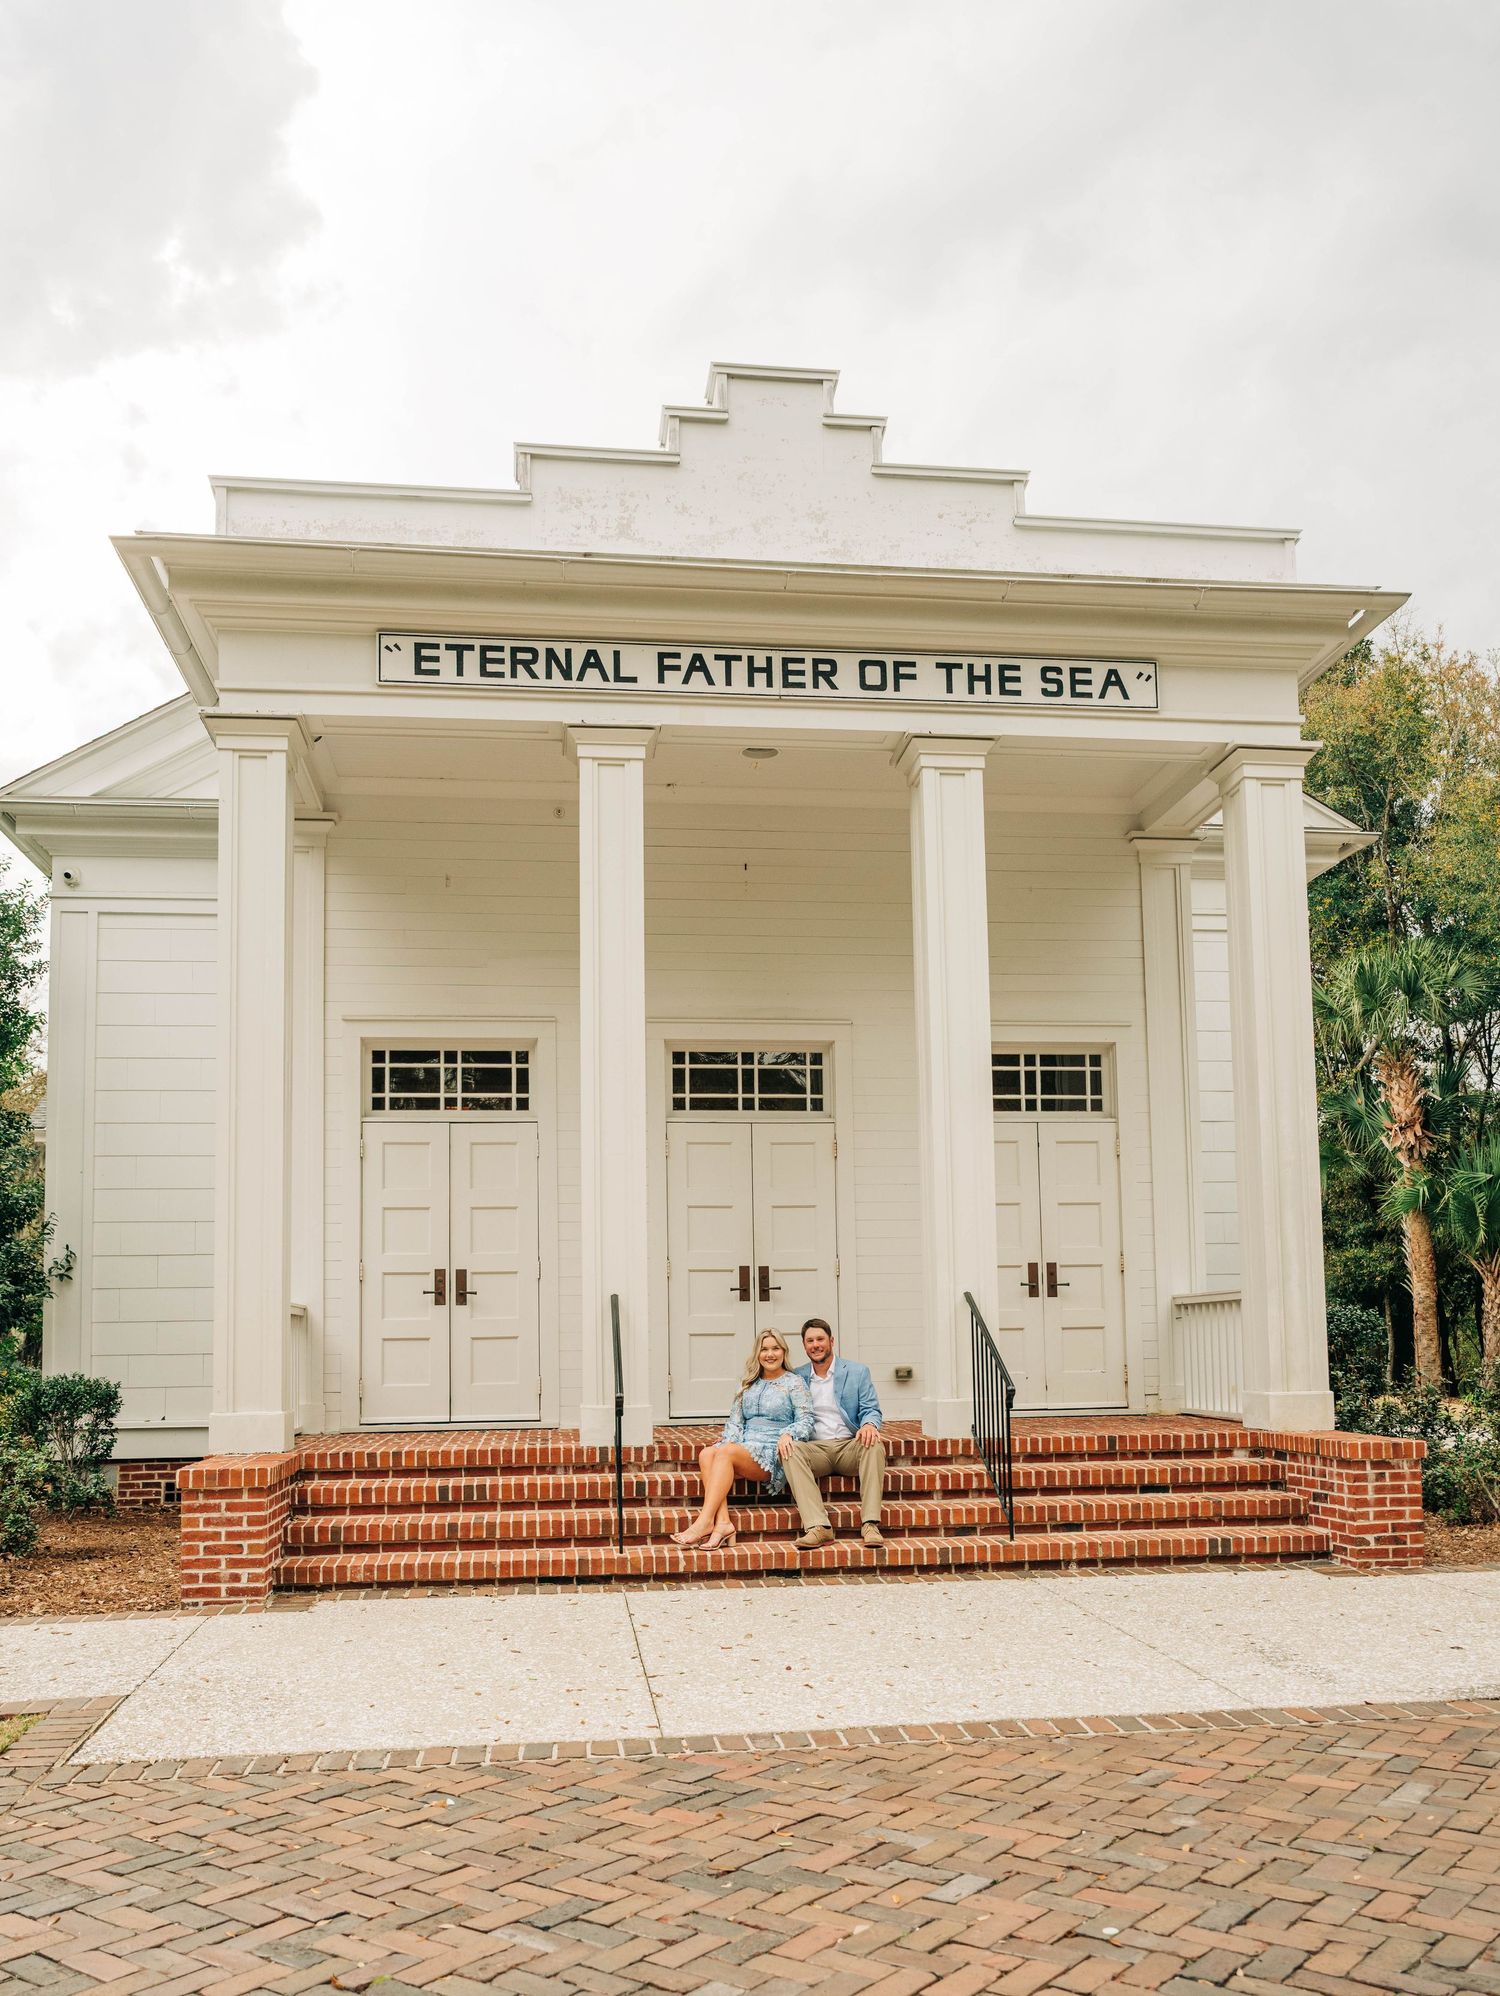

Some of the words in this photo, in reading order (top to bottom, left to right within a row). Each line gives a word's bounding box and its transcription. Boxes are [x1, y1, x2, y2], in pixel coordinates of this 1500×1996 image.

[656, 651, 839, 691] FATHER
[858, 659, 918, 693] OF
[935, 661, 1022, 697] THE
